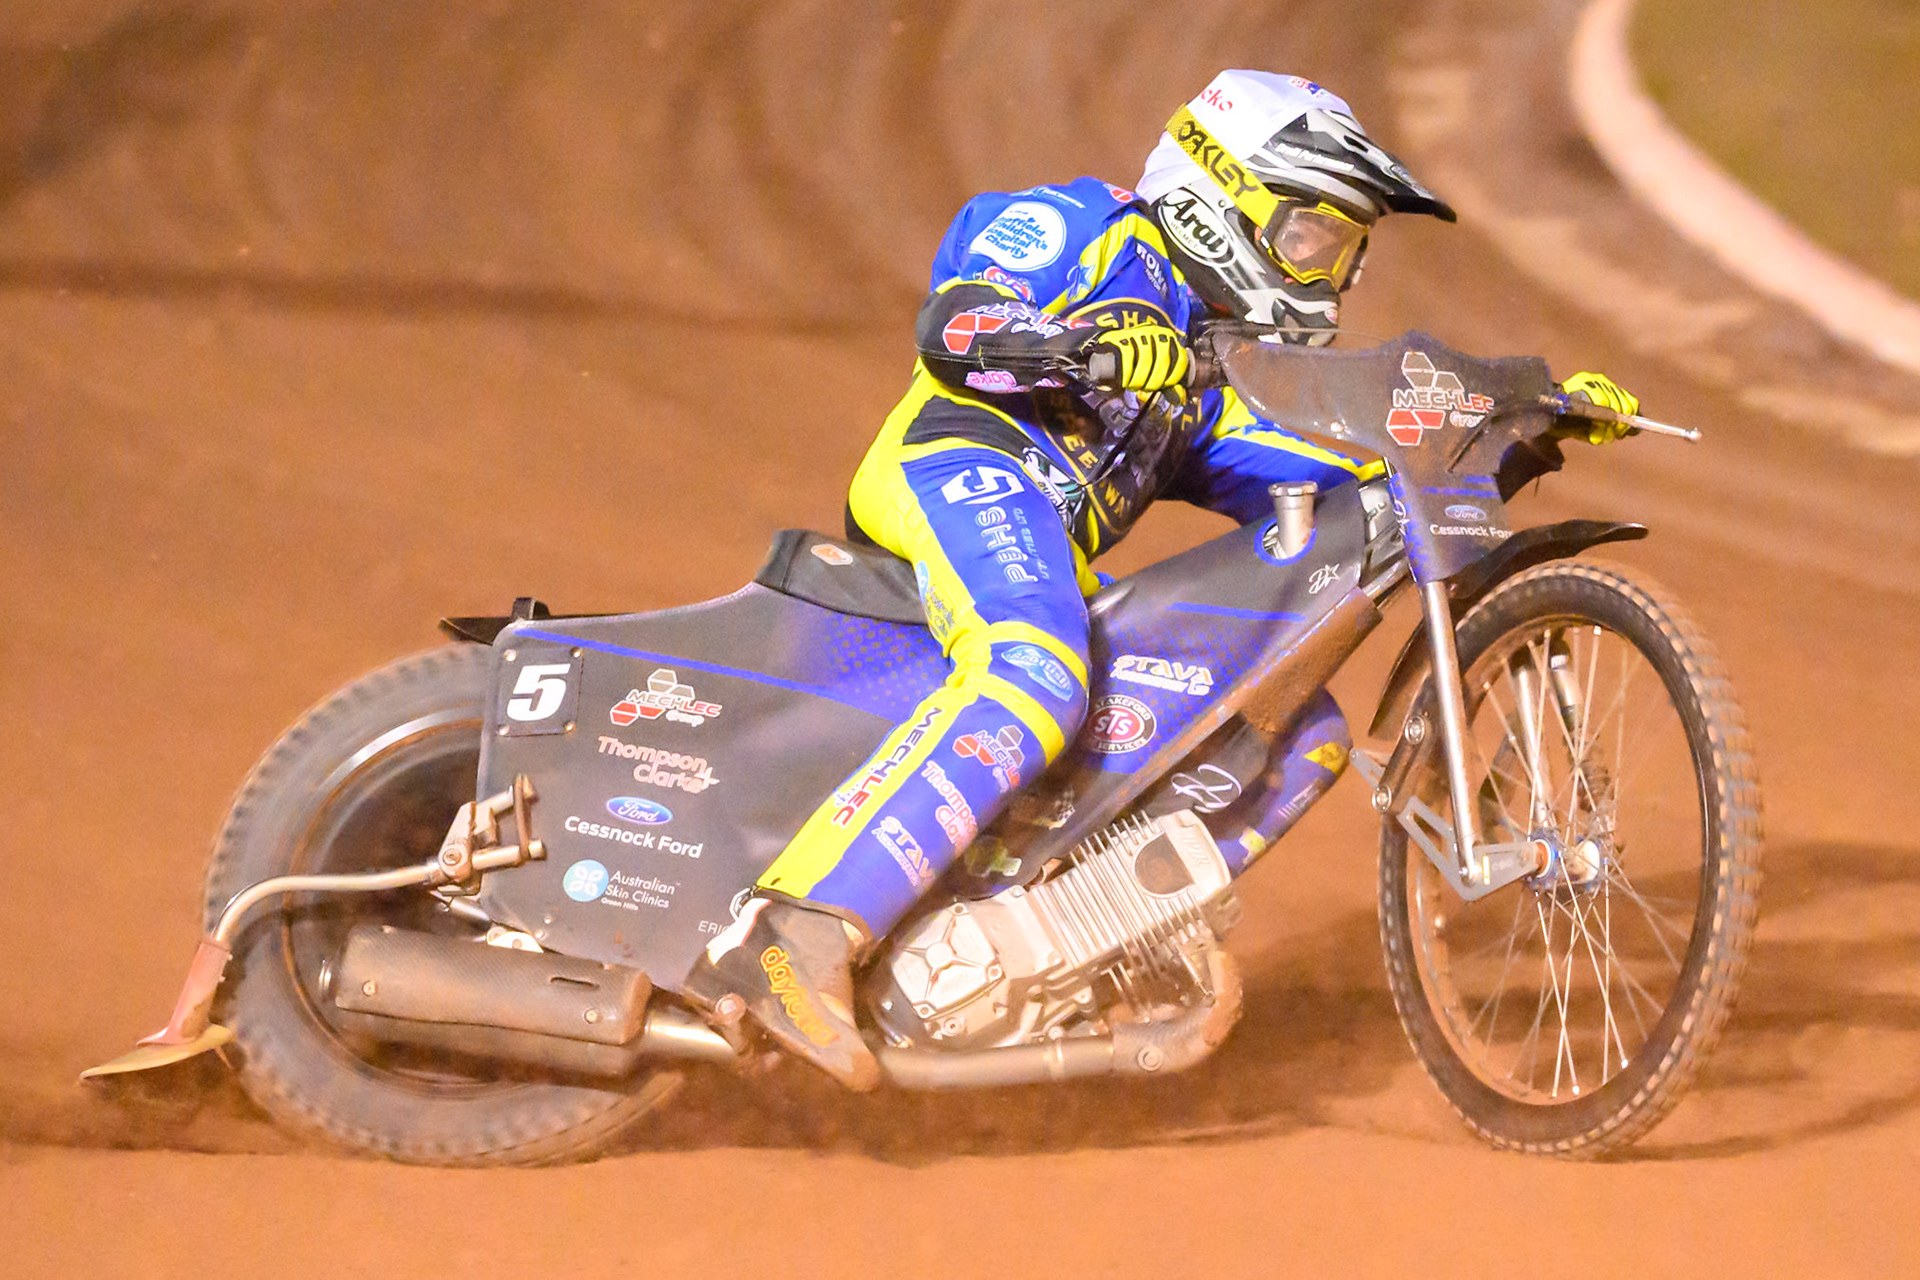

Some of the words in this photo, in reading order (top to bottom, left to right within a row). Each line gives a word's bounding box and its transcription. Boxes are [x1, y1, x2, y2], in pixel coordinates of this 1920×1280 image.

[1177, 120, 1260, 197] OAKLEY
[1163, 189, 1226, 253] Arai
[1169, 221, 1199, 250] HELMET
[985, 235, 1028, 259] Charity
[1392, 388, 1495, 413] MECHLEC
[1429, 523, 1488, 537] Cessnock
[1489, 526, 1513, 539] For
[1113, 655, 1214, 685] STAVA
[506, 663, 571, 722] 5
[625, 689, 723, 718] MECHLEC
[666, 709, 705, 728] Group
[1094, 710, 1132, 735] STS
[598, 736, 708, 778] Thompson
[831, 706, 943, 828] MECHLEC
[633, 763, 704, 794] Clarke
[616, 799, 658, 822] Ford
[564, 816, 655, 849] Cessnock
[658, 835, 703, 859] Ford
[880, 815, 935, 881] STAV
[604, 884, 629, 900] Skin
[631, 889, 670, 909] Clinics
[610, 870, 676, 895] Australian
[600, 897, 622, 908] Green
